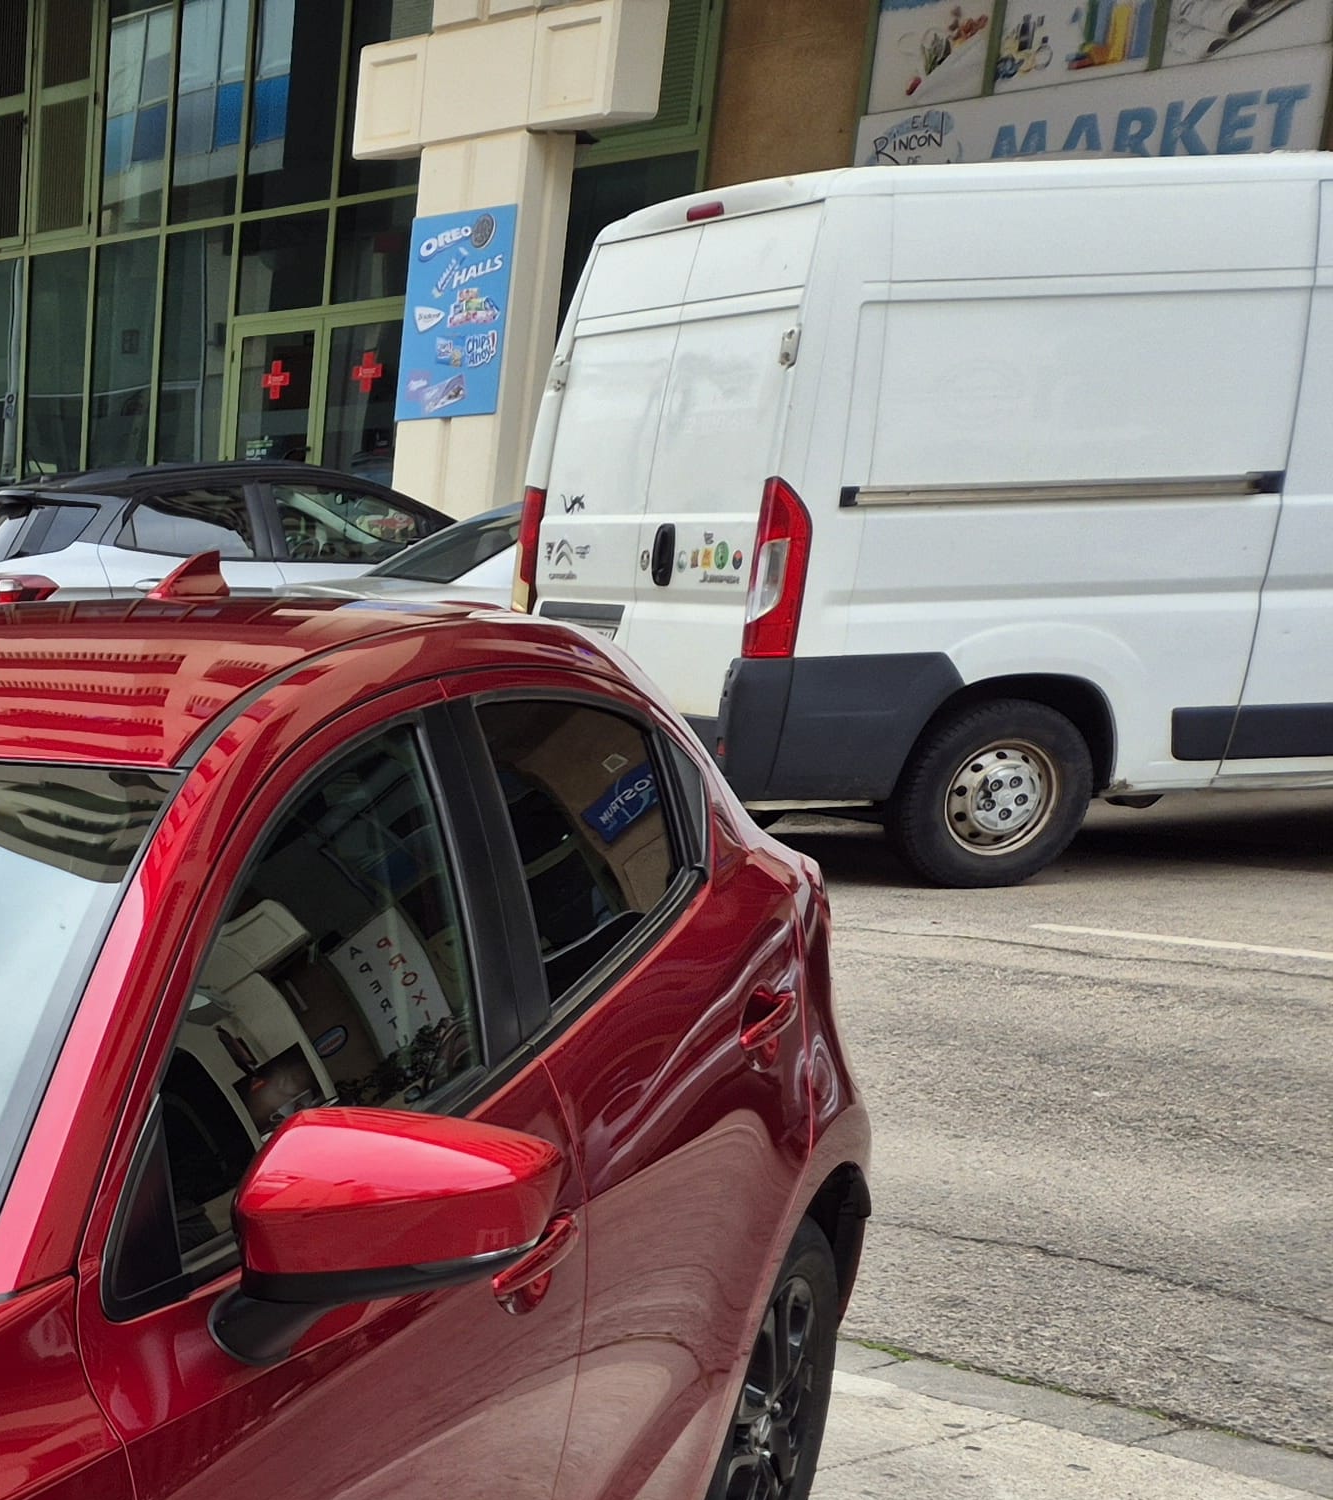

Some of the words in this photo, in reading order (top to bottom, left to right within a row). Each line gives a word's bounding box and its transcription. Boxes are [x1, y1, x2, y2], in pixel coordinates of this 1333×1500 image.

[911, 115, 929, 129] EL
[990, 84, 1312, 159] MARKET
[420, 226, 471, 257] OREO
[452, 254, 503, 289] HALLS
